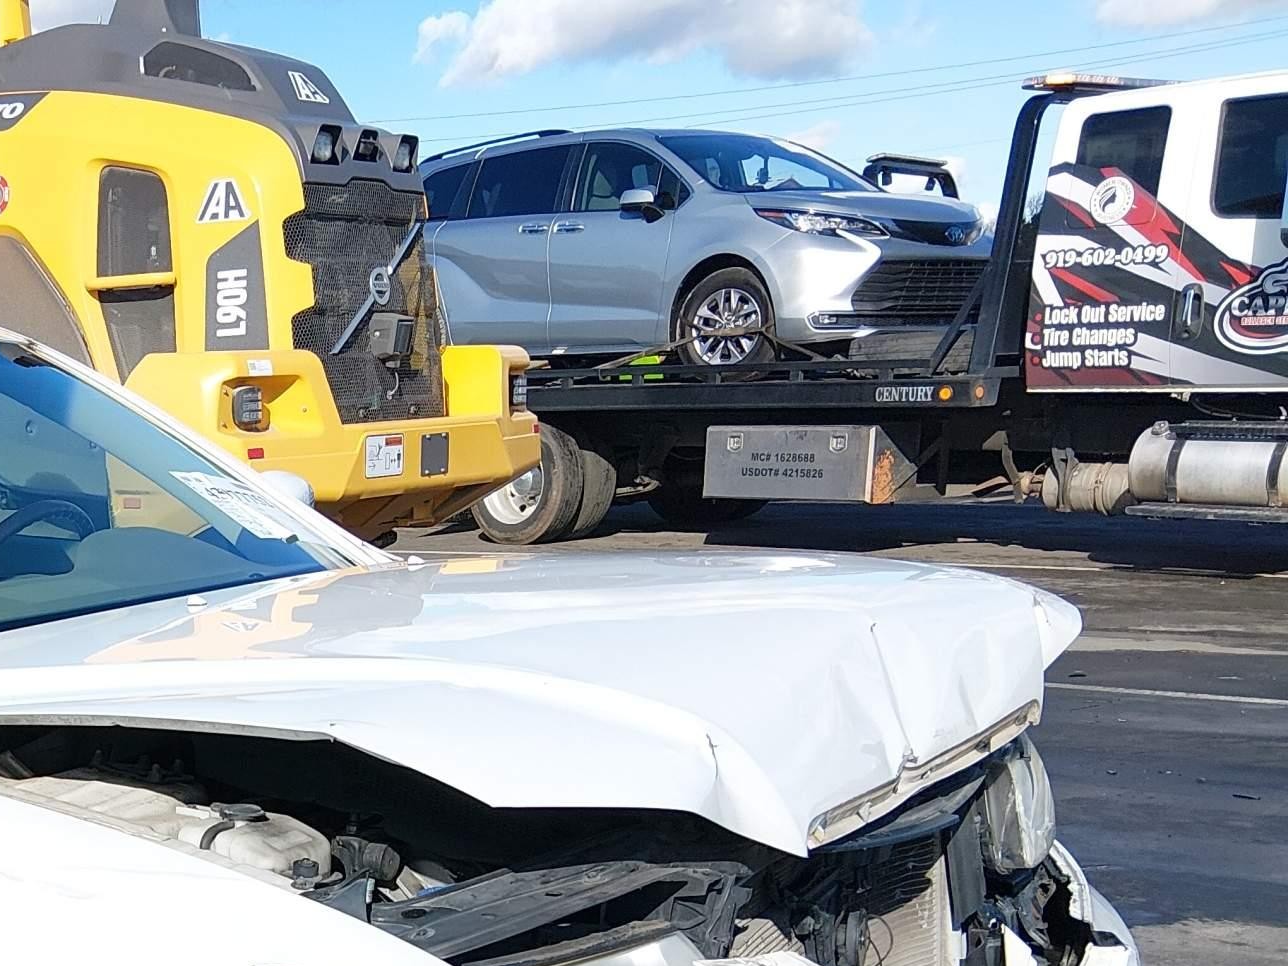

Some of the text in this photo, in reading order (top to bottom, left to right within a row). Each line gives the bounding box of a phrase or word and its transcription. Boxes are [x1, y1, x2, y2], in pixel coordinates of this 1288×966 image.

[1044, 244, 1170, 269] 919-602-0499
[1044, 302, 1165, 325] Lock Out Service
[1231, 295, 1288, 317] CAP
[1042, 326, 1135, 347] Tire Changes
[1041, 348, 1129, 370] Jump Starts
[874, 386, 935, 402] CENTURY
[751, 452, 772, 463] MC#
[741, 467, 824, 478] USDOT# 4215826
